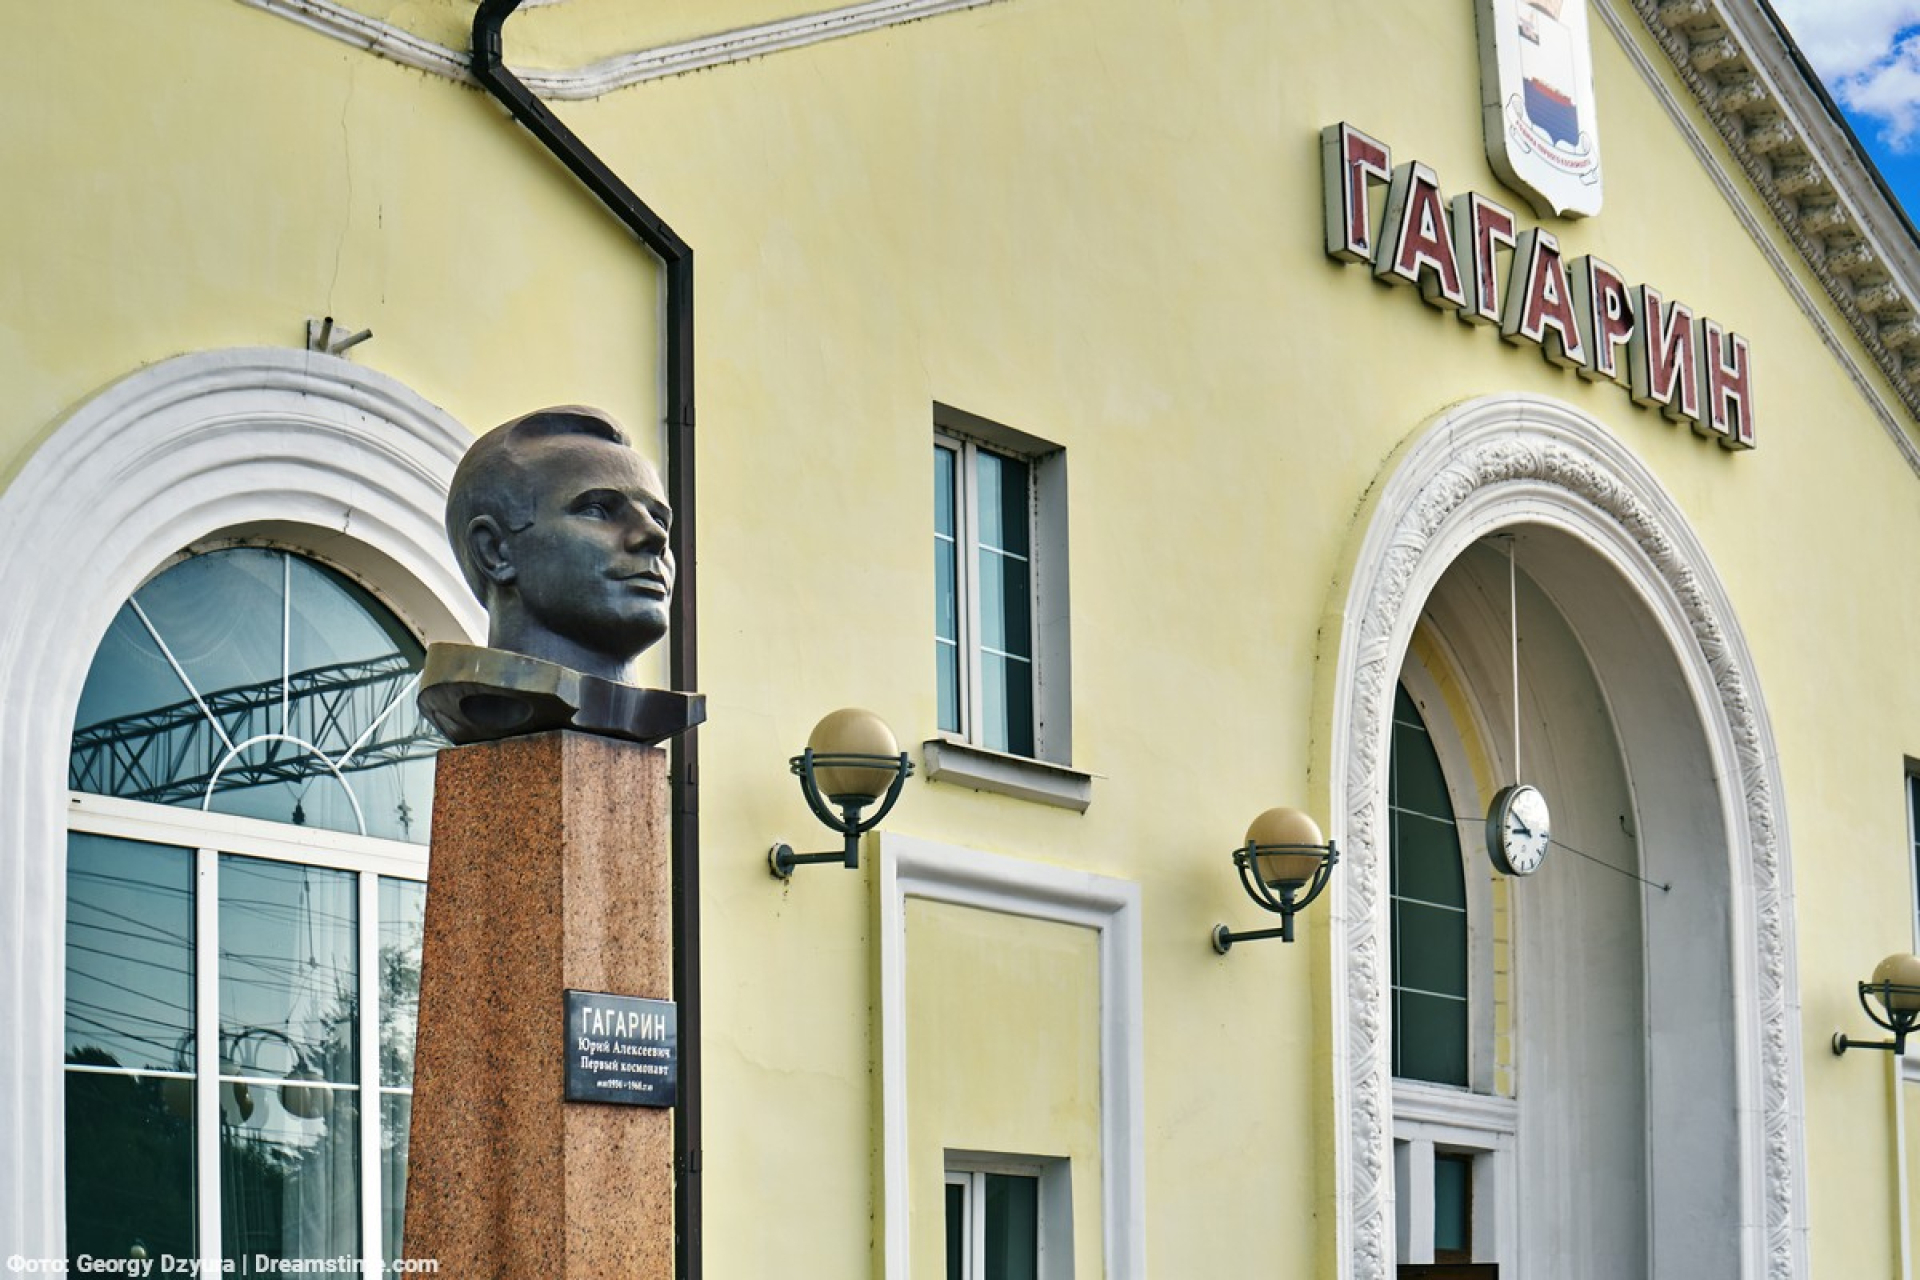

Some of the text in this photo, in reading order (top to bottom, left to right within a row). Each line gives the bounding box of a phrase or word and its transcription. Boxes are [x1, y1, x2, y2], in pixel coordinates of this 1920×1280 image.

[1322, 121, 1755, 450] ГАГАРИН
[582, 1007, 666, 1041] ГАГАРИН
[578, 1036, 671, 1058] Юрий Алексеевич
[580, 1055, 669, 1075] Первый космонавт
